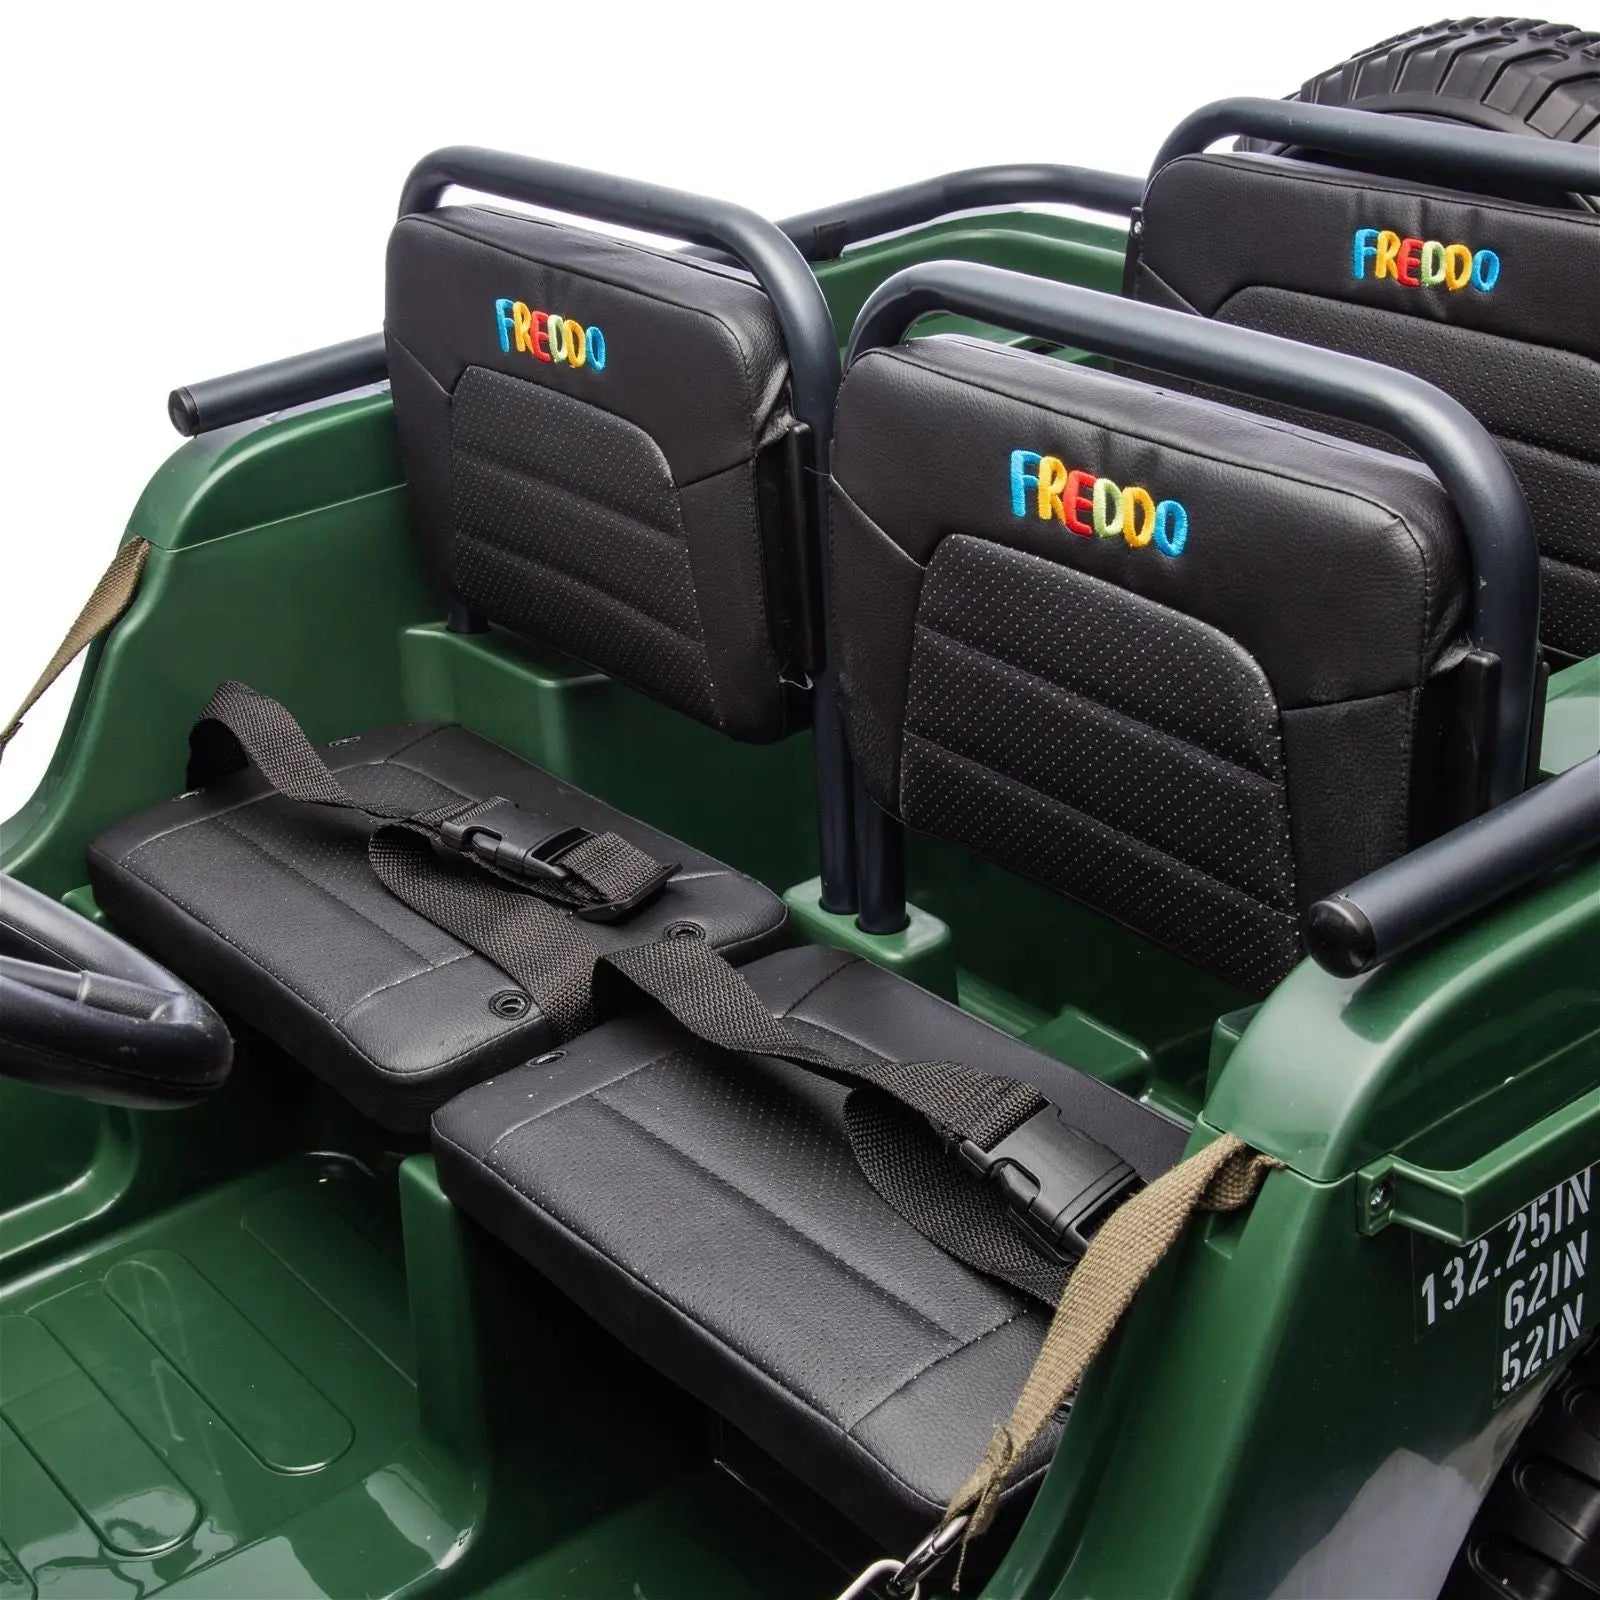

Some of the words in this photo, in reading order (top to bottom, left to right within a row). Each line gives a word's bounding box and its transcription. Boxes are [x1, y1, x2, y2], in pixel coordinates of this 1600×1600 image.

[1353, 228, 1500, 293] FREDDO
[495, 298, 606, 371] FREDDO
[1010, 449, 1188, 559] FREDDO
[1504, 1230, 1588, 1330] 62IN
[1502, 1292, 1584, 1392] 52IN
